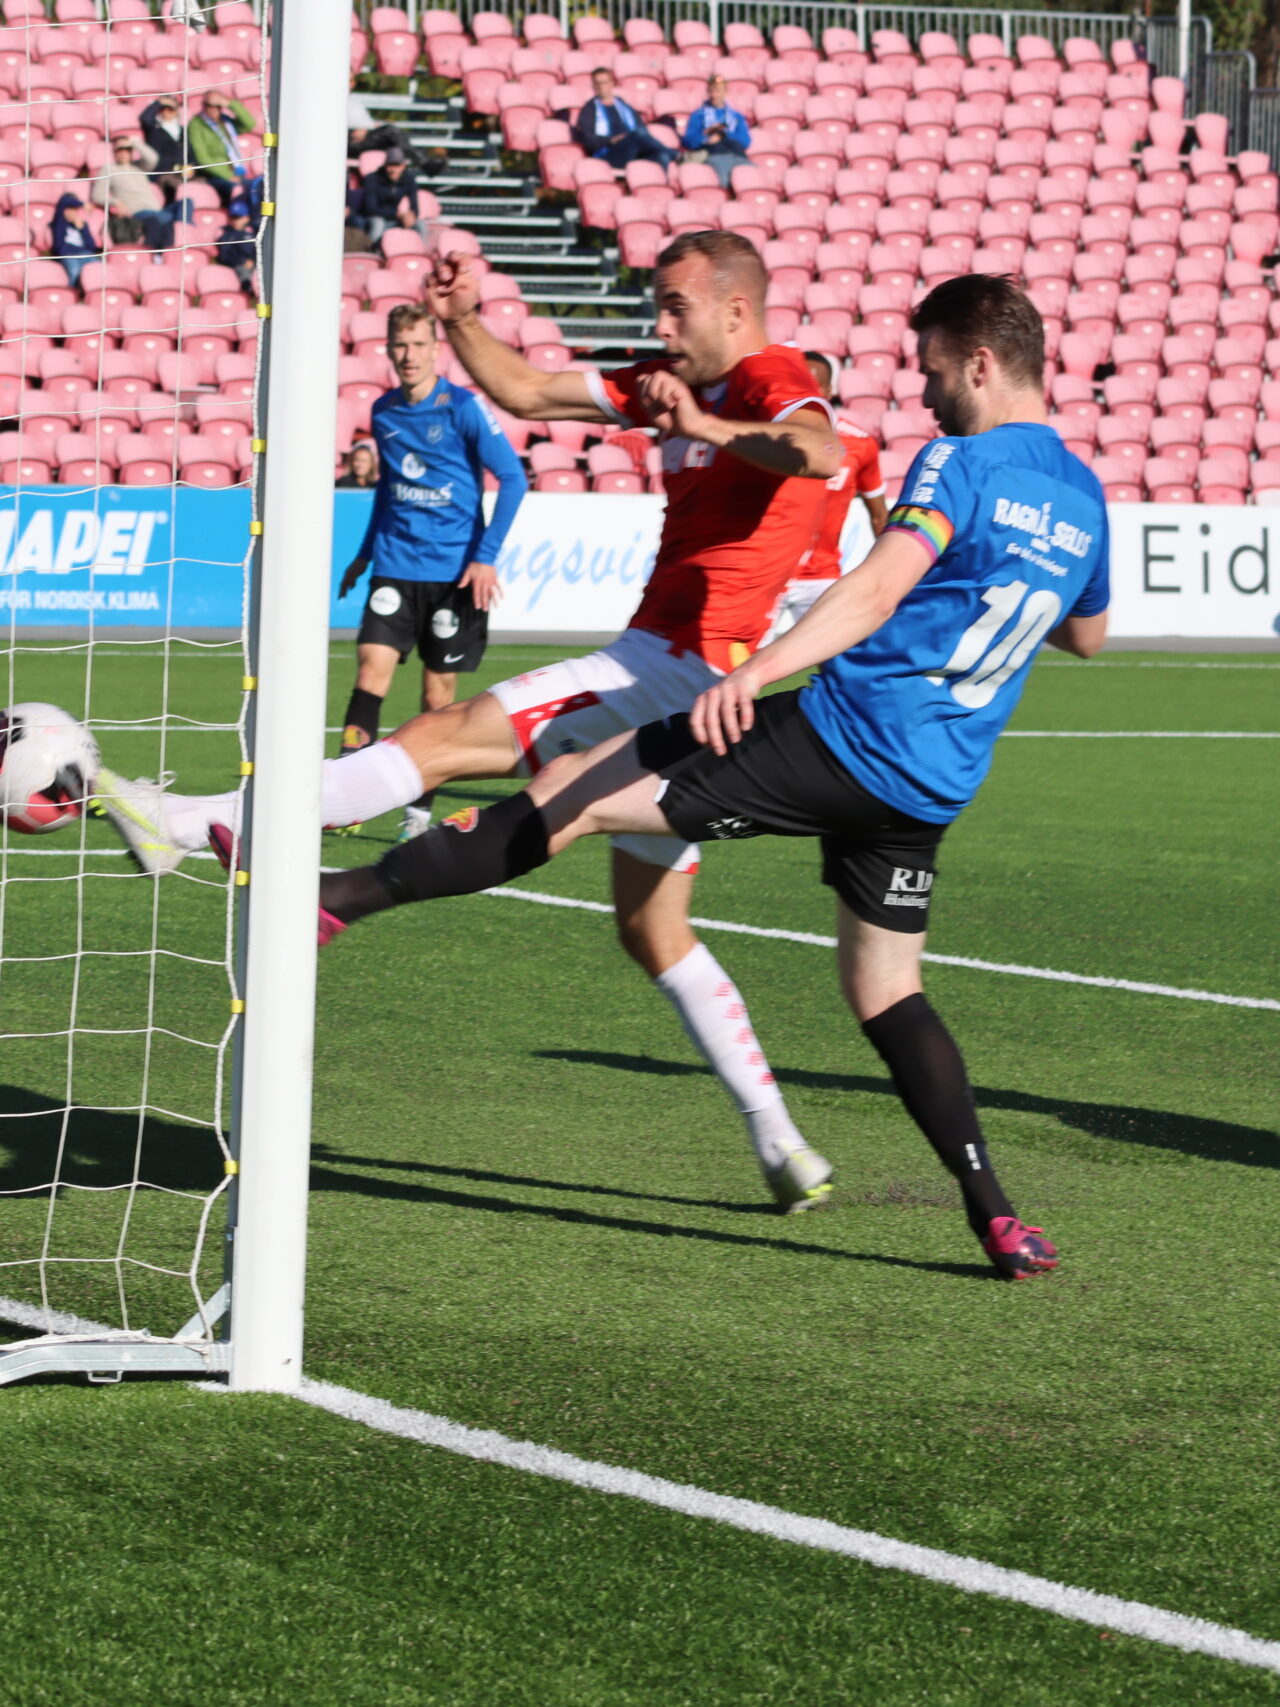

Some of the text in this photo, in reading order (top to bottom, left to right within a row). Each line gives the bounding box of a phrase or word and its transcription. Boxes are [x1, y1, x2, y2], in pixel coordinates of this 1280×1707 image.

[34, 591, 107, 610] NORDISK
[108, 592, 159, 611] KLIMA
[923, 580, 1063, 709] 10
